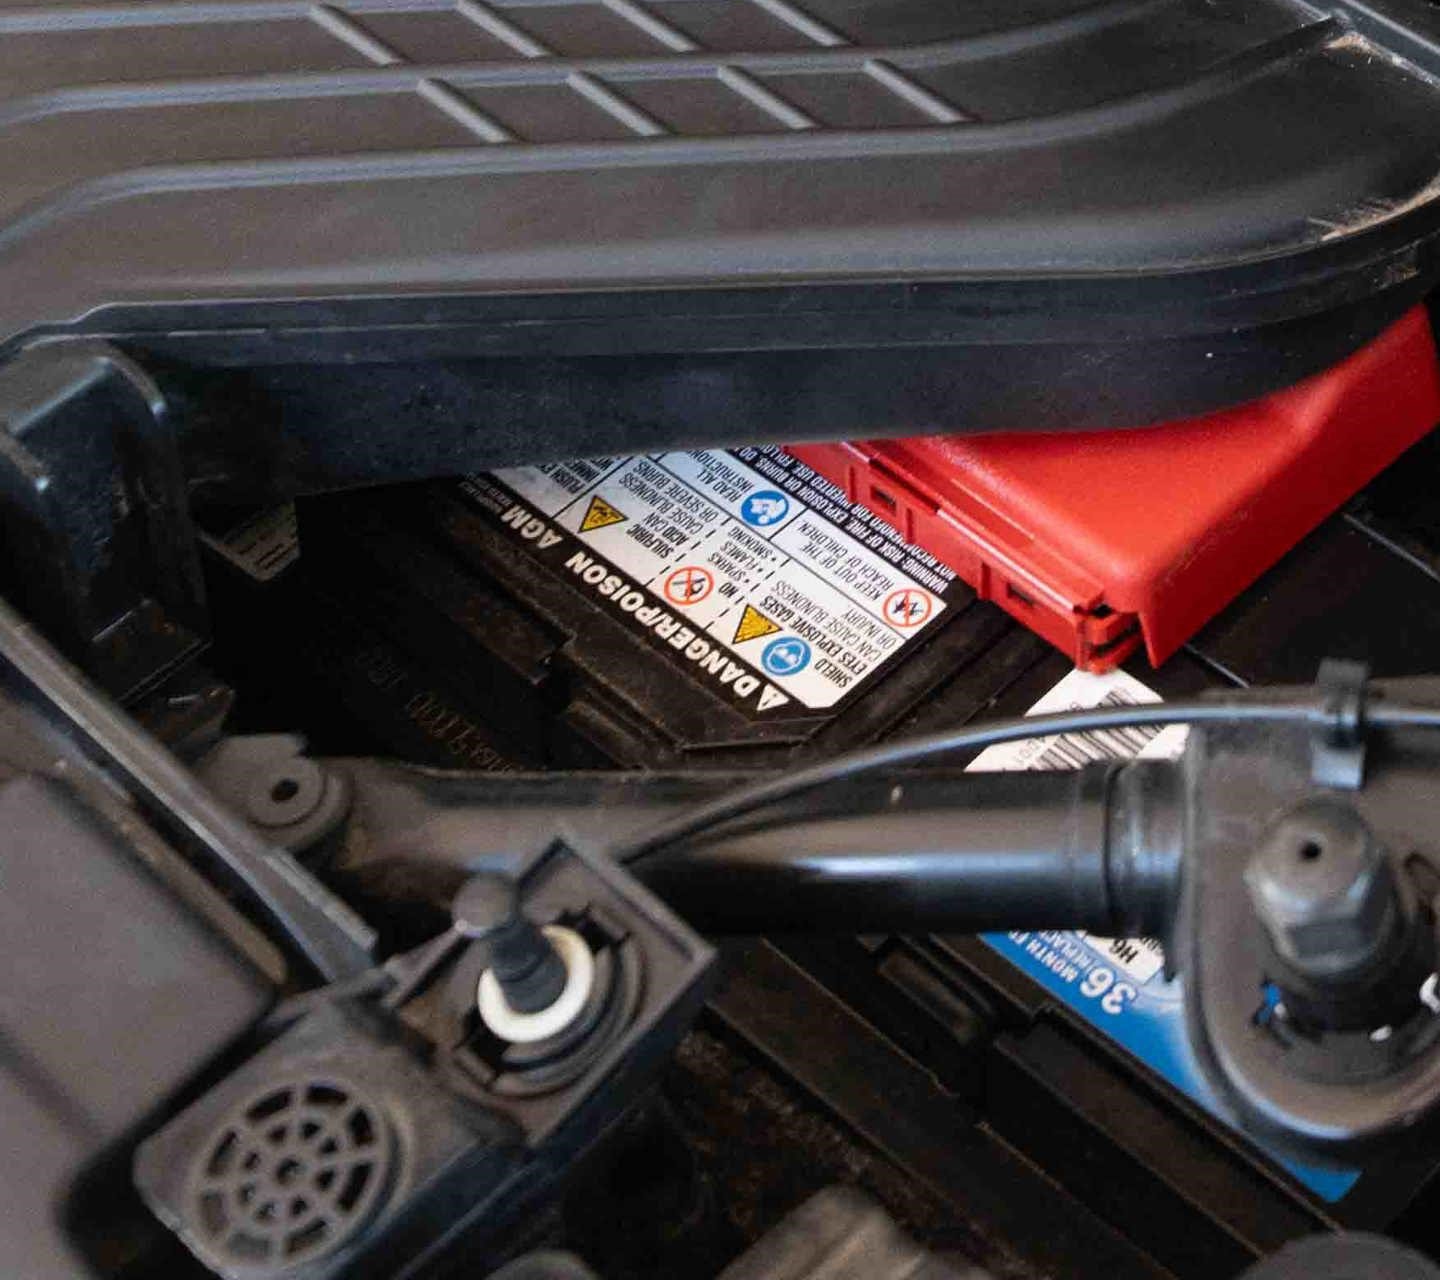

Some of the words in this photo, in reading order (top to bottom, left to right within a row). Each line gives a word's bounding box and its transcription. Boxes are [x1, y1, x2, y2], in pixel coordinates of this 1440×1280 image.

[695, 467, 717, 486] ALL
[711, 479, 741, 503] READ
[782, 475, 802, 491] OR
[617, 471, 674, 515] BLINDNESS
[664, 481, 705, 513] SEVERE
[796, 483, 848, 524] EXPLOSION
[499, 502, 564, 554] AGM
[642, 510, 669, 533] CAN
[667, 506, 704, 536] CAUSE
[698, 505, 719, 523] OR
[625, 521, 674, 560] SULFURIC
[660, 524, 689, 548] ACID
[726, 524, 773, 561] SMOKING
[799, 540, 823, 560] THE
[863, 531, 884, 548] OF
[706, 550, 746, 582] SPARKS
[719, 540, 759, 571] FLAMES
[818, 553, 837, 569] OF
[843, 552, 862, 569] OF
[877, 540, 905, 563] RISK
[833, 564, 857, 583] OUT
[857, 562, 894, 591] REACH
[717, 580, 739, 598] NO
[770, 578, 829, 624] BLINDNESS
[852, 577, 883, 602] KEEP
[758, 594, 794, 623] GASES
[563, 548, 761, 699] DANGER/POISON
[788, 615, 843, 658] EXPLOSIVE
[822, 616, 861, 647] CAUSE
[855, 640, 882, 662] CAN
[874, 631, 897, 650] OR
[813, 656, 853, 688] SHIELD
[836, 650, 867, 675] EYES
[1026, 938, 1079, 983] MONTH
[1079, 966, 1137, 1015] 36
